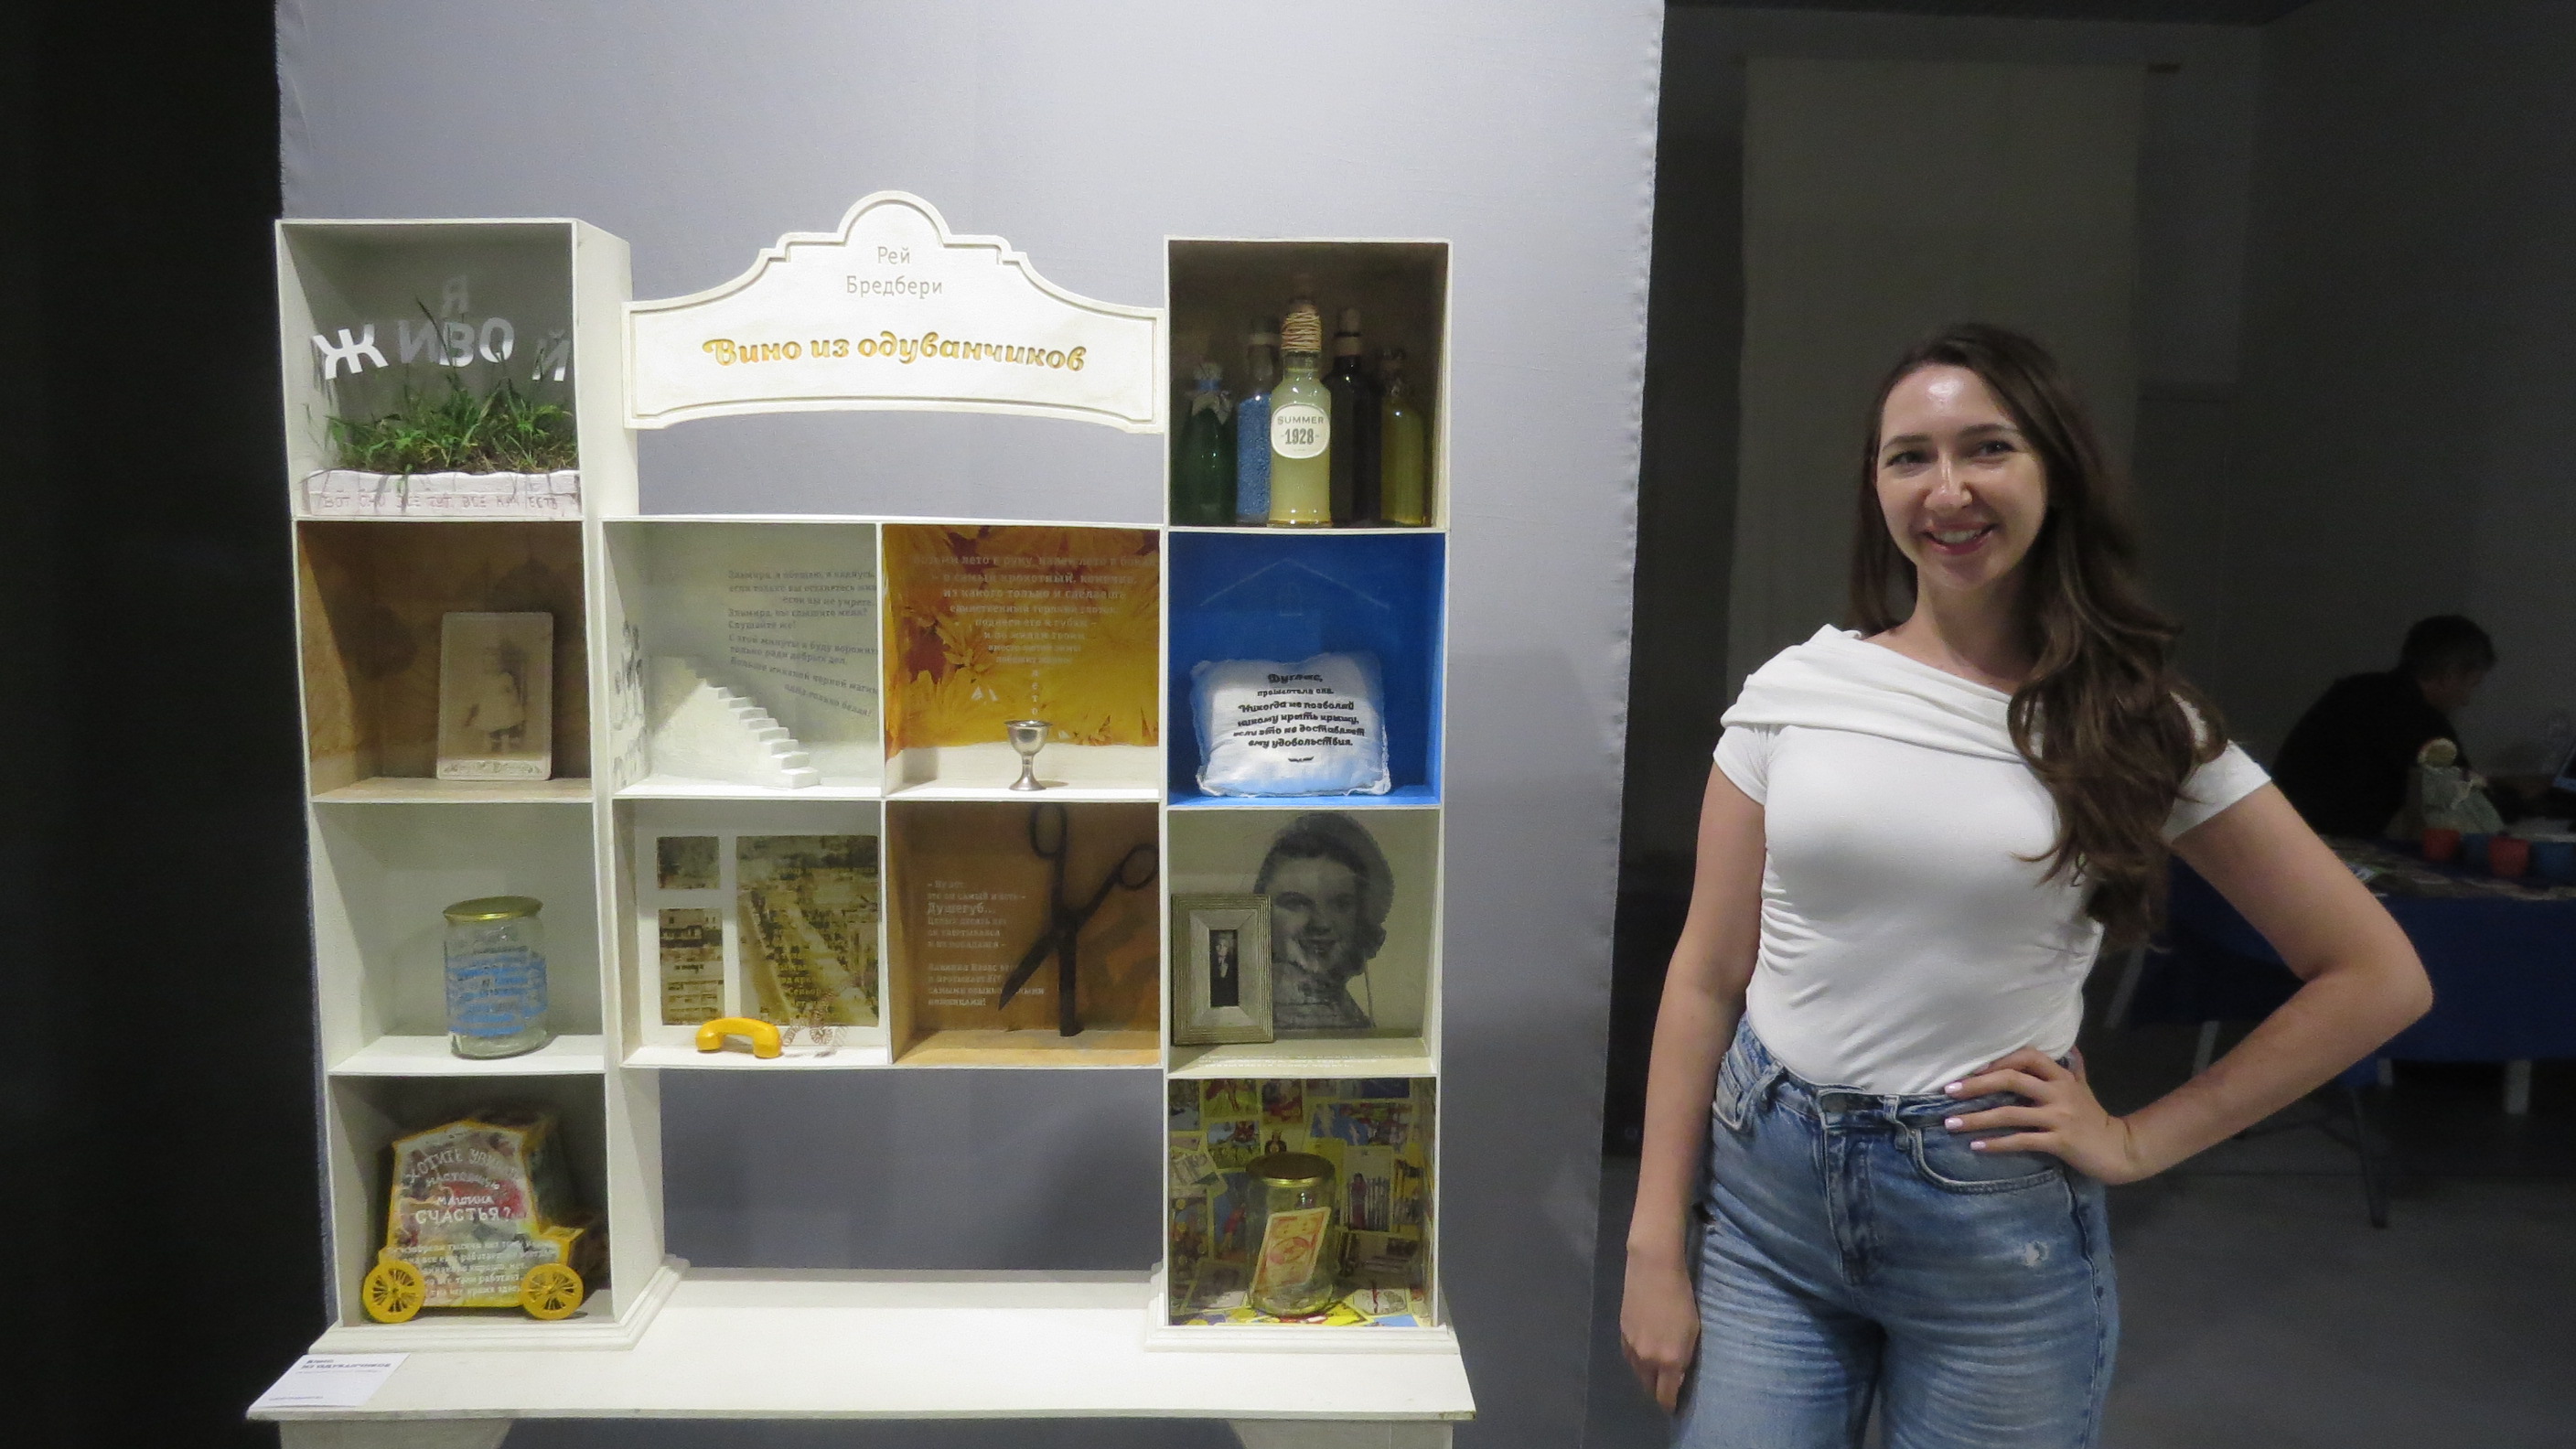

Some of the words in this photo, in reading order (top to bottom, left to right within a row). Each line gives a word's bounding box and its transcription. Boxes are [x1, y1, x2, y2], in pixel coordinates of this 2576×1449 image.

[877, 246, 911, 266] Рей
[846, 274, 943, 300] Бредбери
[703, 338, 802, 367] Вино
[810, 337, 850, 359] из
[857, 330, 1087, 373] одуванчиков
[1277, 415, 1325, 425] SUMMER
[1237, 700, 1287, 714] Никогда
[1289, 701, 1303, 709] не
[1304, 700, 1355, 711] позволяй
[1237, 714, 1279, 727] никому
[1248, 739, 1270, 749] ему
[1272, 736, 1354, 749] удовольствия.
[414, 1206, 512, 1225] СЧАСТЬЯ?
